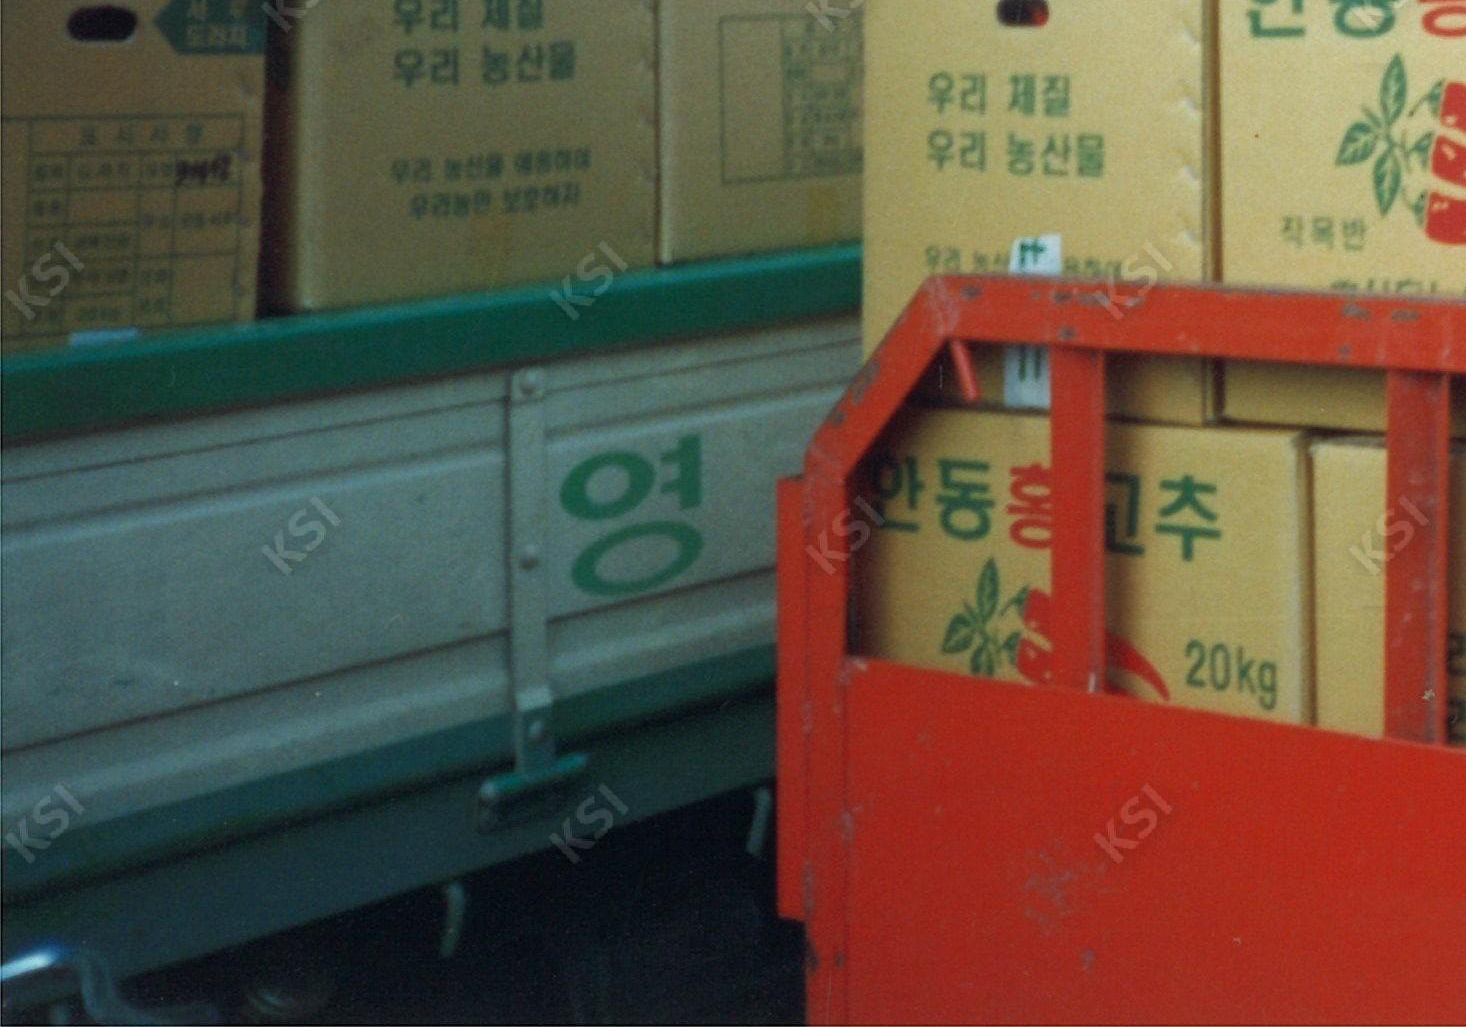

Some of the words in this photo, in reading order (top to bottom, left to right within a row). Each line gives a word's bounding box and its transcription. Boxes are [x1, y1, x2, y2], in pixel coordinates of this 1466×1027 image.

[393, 48, 460, 89] 우리
[482, 42, 577, 83] 농산물
[928, 71, 987, 116] 우리
[1008, 73, 1072, 118] 체질
[926, 128, 987, 173] 우리
[1007, 132, 1106, 178] 농산물
[559, 435, 705, 597] 영
[1184, 639, 1278, 711] 20kg
